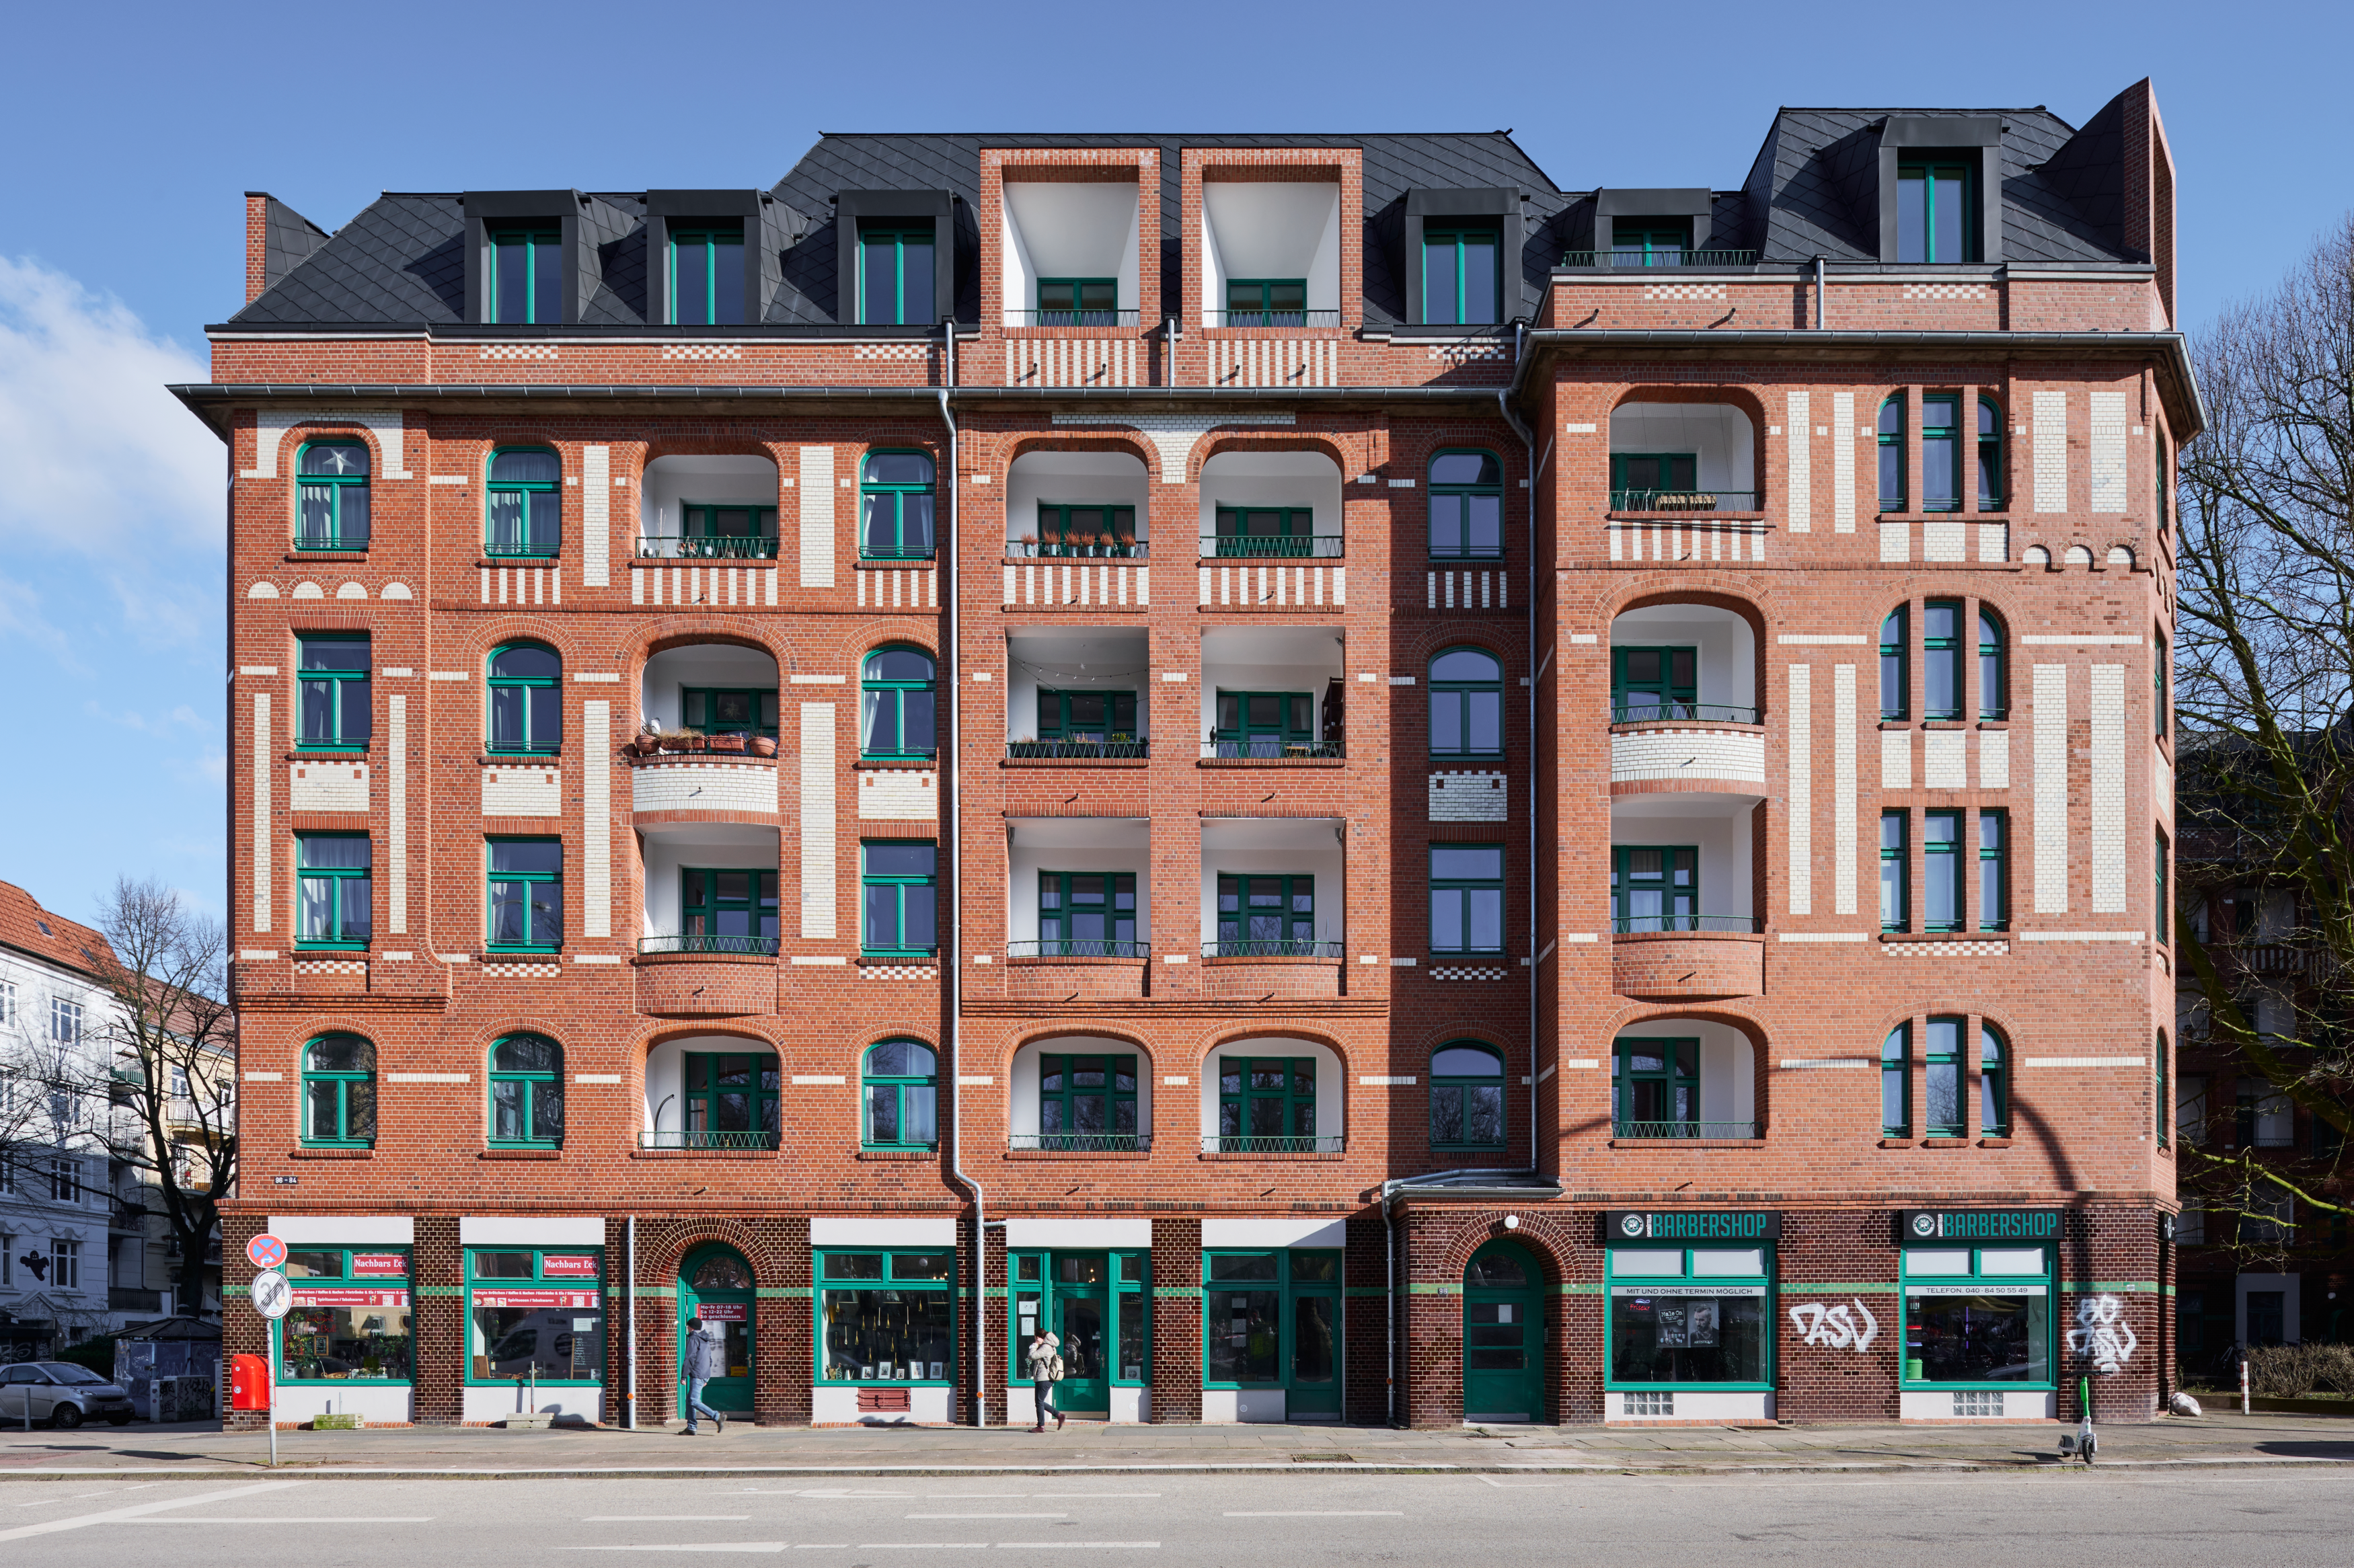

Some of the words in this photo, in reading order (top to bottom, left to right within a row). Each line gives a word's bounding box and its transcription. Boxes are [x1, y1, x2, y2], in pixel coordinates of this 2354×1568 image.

[1653, 1214, 1767, 1237] BARBERSHOP
[1944, 1213, 2057, 1237] BARBERSHOP
[354, 1259, 391, 1267] Nachbars
[393, 1259, 407, 1267] Eck
[545, 1259, 581, 1268] Nachbars
[584, 1260, 597, 1268] Eck
[1630, 1303, 1650, 1311] Friseur
[321, 1325, 336, 1333] Bull
